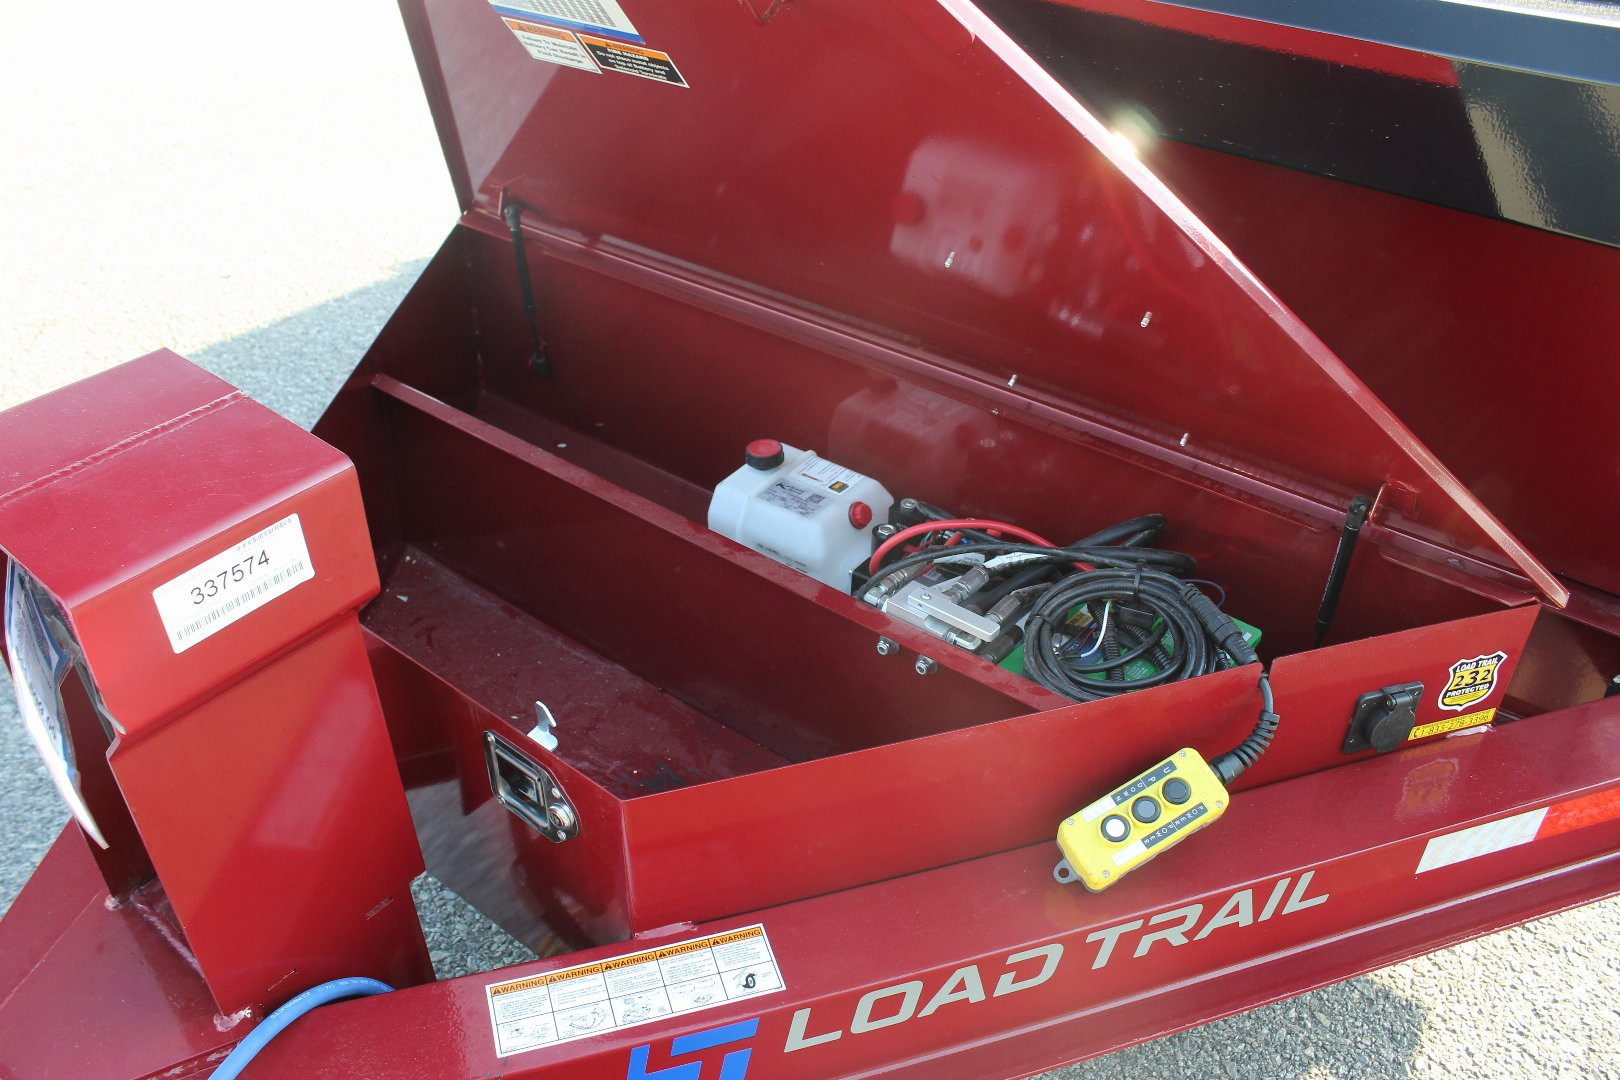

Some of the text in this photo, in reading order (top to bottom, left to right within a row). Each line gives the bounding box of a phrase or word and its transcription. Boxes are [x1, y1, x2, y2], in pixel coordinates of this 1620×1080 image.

[607, 47, 649, 61] FIRE HAZARD
[612, 43, 644, 54] WARNING
[615, 54, 631, 63] place
[631, 57, 647, 65] metal
[647, 61, 669, 71] objects
[632, 62, 654, 73] Battery
[654, 67, 666, 75] and
[190, 549, 270, 605] 337574
[1456, 656, 1499, 673] LOAD TRAIL
[1453, 669, 1491, 687] 232
[1445, 683, 1490, 698] PROTECTED
[1147, 766, 1172, 782] UP
[1115, 782, 1144, 802] DOWN
[1174, 805, 1204, 826] POWER
[1144, 824, 1174, 845] POWER
[719, 929, 761, 944] WARNING
[666, 941, 709, 956] WARNING
[612, 952, 656, 969] WARNING
[783, 870, 1330, 1053] LOAD TRAIL
[556, 965, 600, 981] WARNING
[501, 978, 545, 994] WARNING
